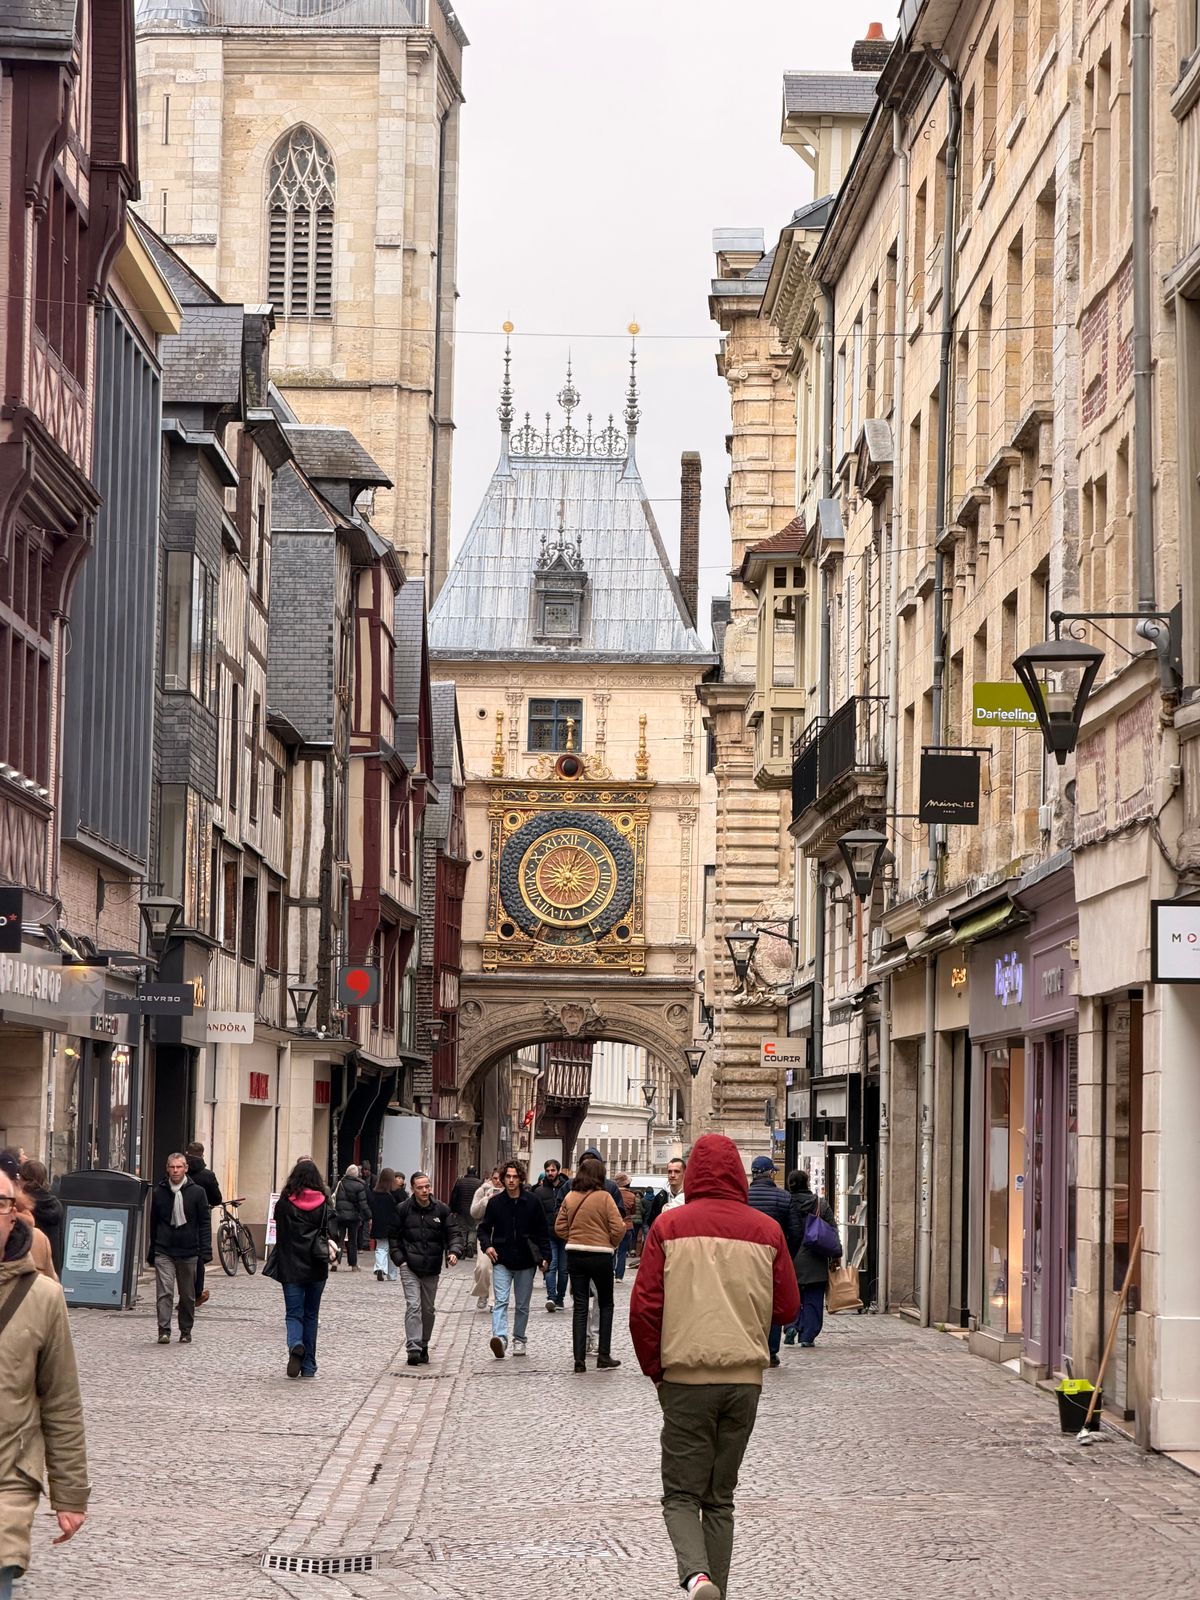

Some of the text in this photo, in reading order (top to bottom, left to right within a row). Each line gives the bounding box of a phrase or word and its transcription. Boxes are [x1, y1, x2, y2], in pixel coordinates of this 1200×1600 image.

[976, 708, 1036, 722] Darjeeling
[542, 838, 557, 852] XI
[530, 851, 542, 863] X
[596, 854, 607, 864] II
[600, 872, 611, 884] III
[581, 905, 592, 917] V
